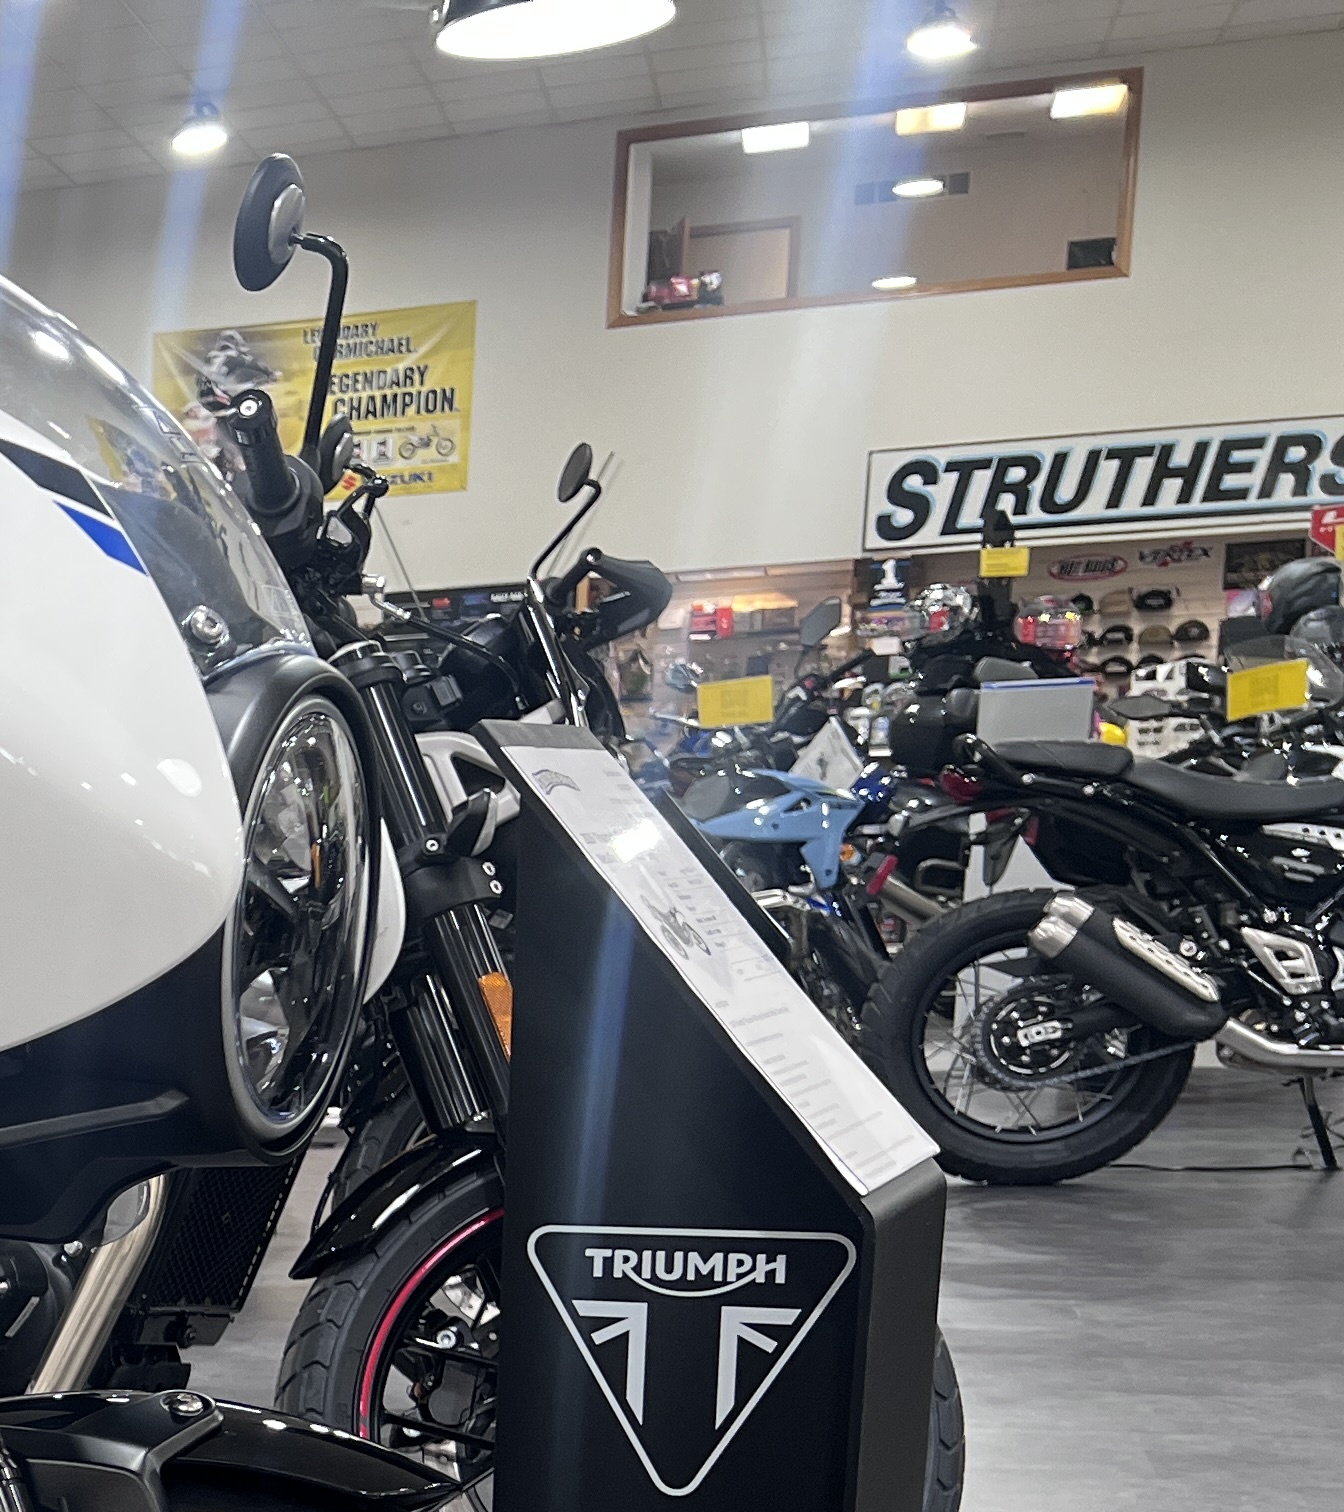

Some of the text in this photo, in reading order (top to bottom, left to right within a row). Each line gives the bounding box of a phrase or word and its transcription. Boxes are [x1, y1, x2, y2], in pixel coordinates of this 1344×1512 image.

[303, 321, 378, 344] LEDARY
[328, 364, 429, 394] EGENDARY
[388, 471, 434, 485] ZUKI
[585, 1248, 787, 1297] TRIUMPH
